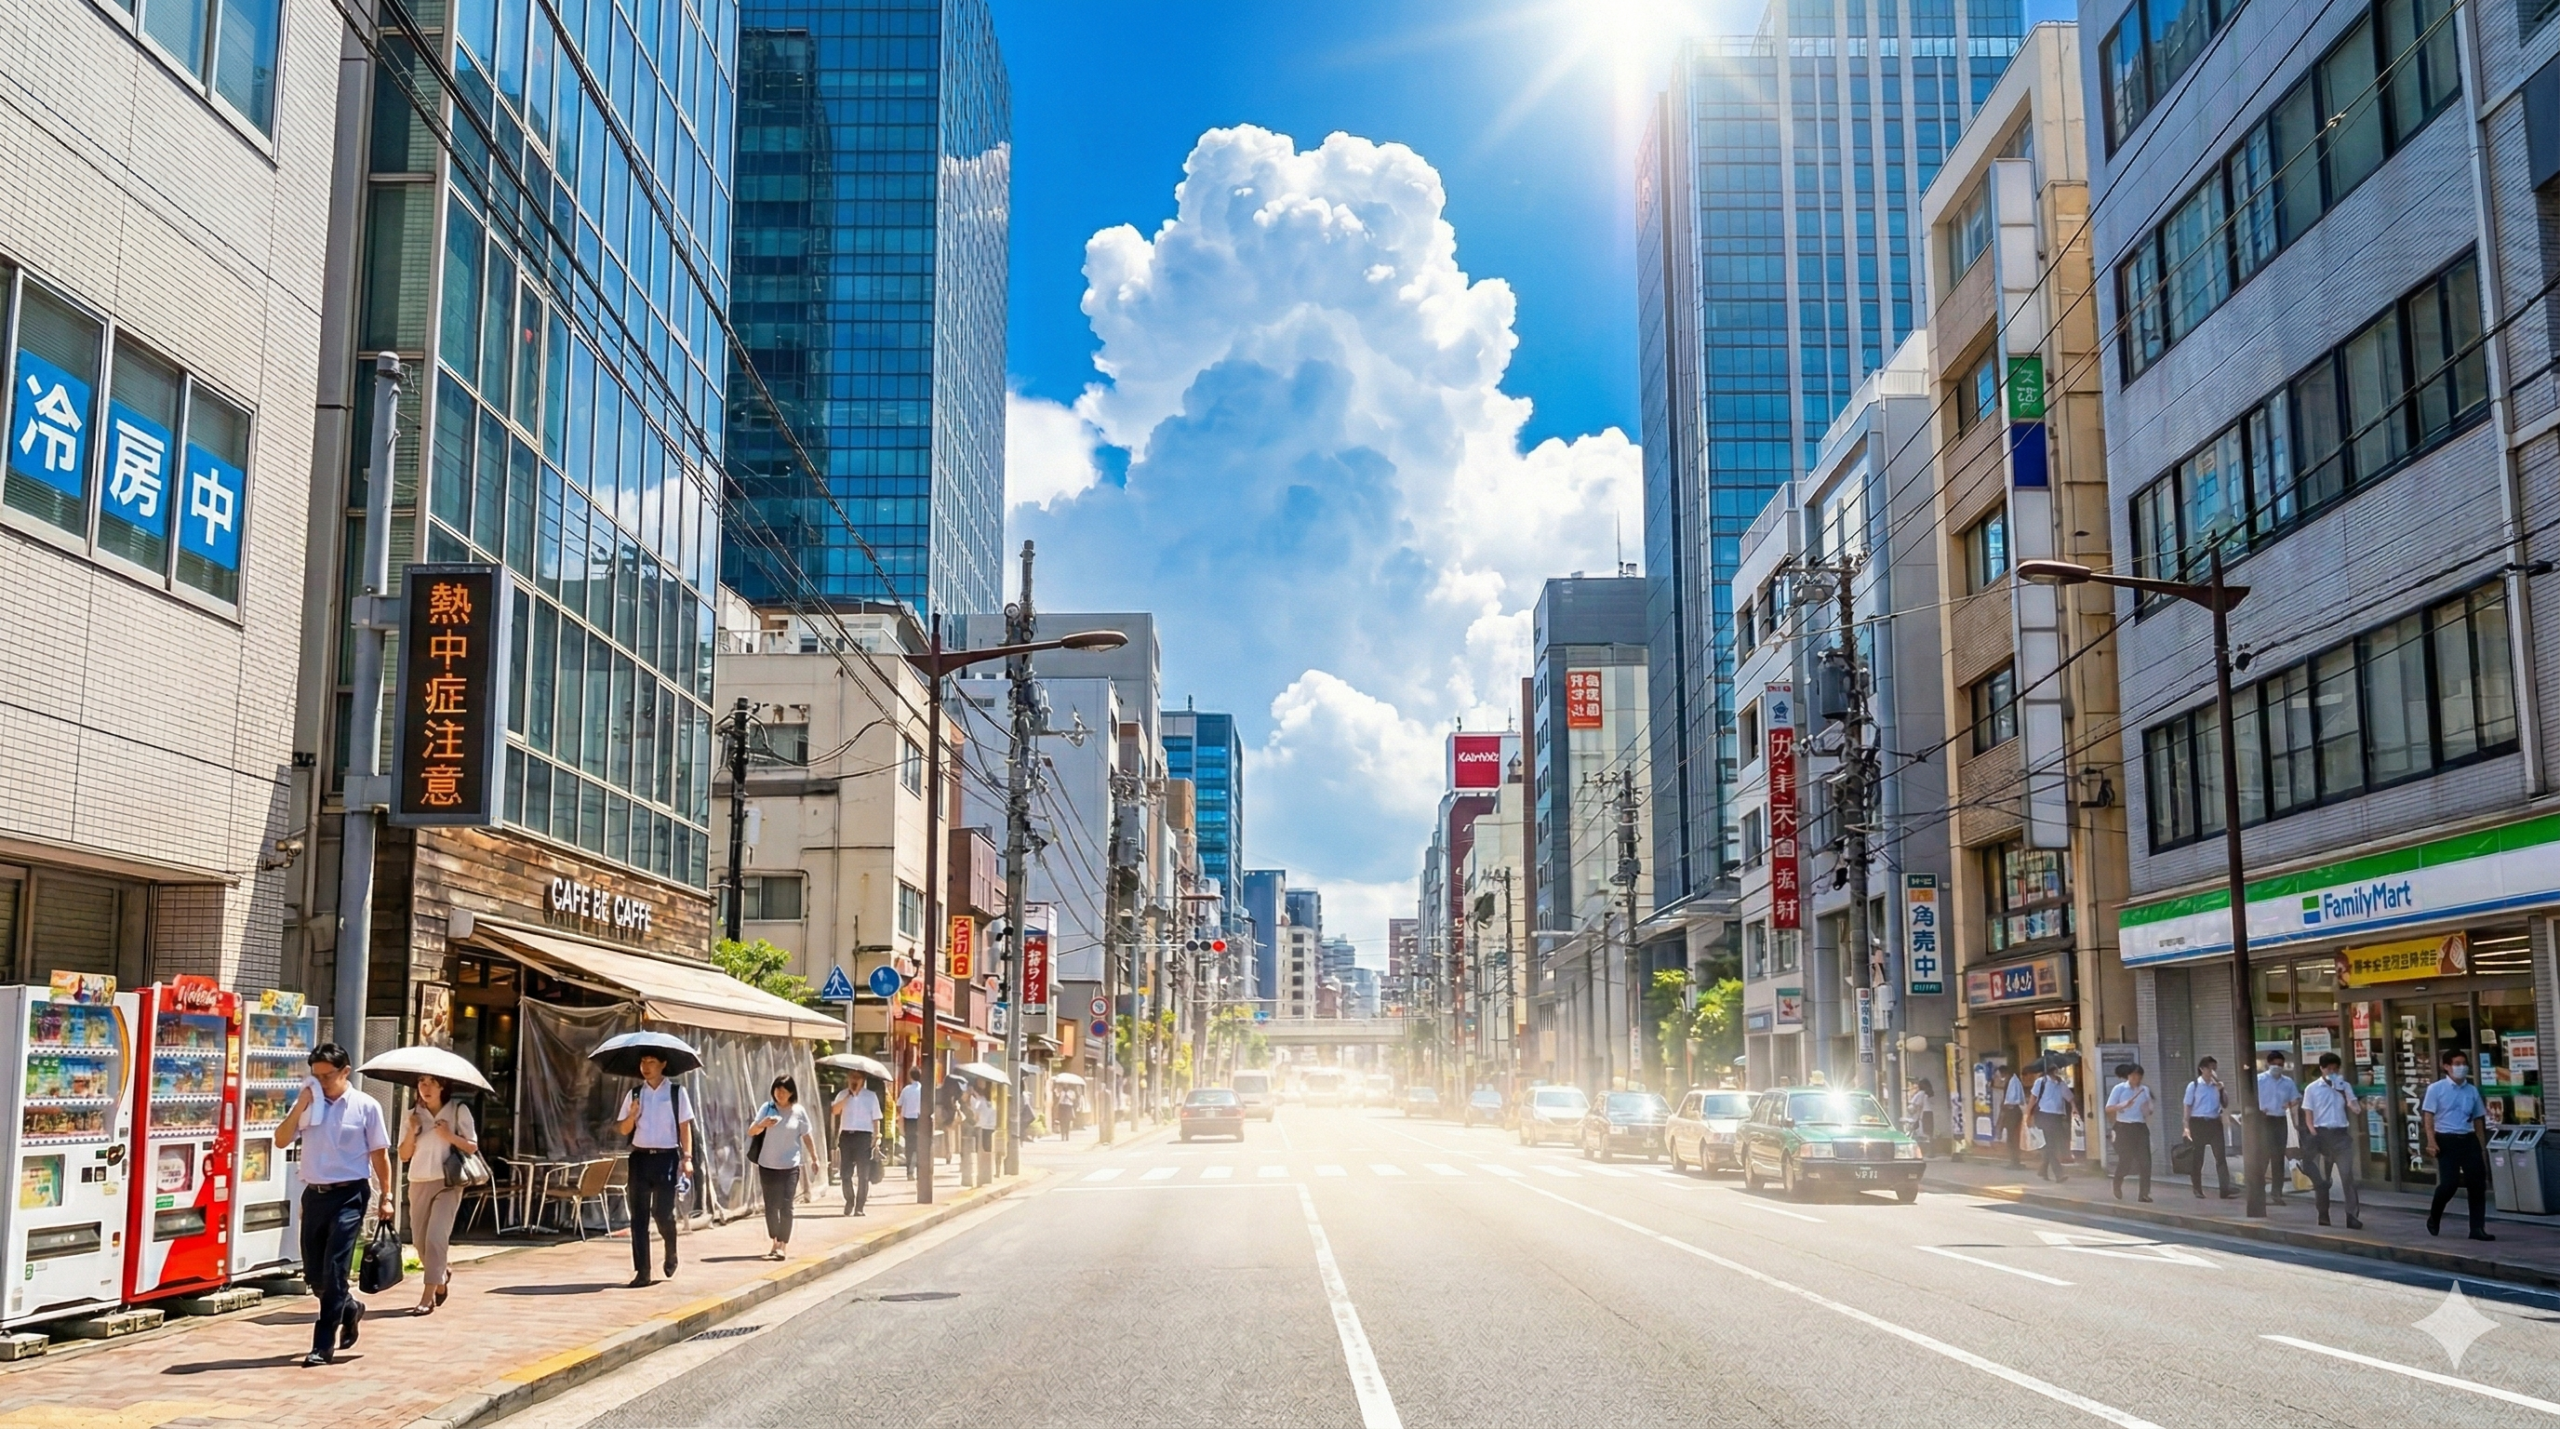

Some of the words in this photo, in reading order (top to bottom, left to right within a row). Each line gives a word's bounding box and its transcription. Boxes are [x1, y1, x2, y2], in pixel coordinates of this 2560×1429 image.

[19, 374, 234, 547] 冷房中
[420, 582, 472, 806] 熱中症注意
[552, 877, 590, 917] CAFE
[2324, 880, 2412, 920] FamilyMart
